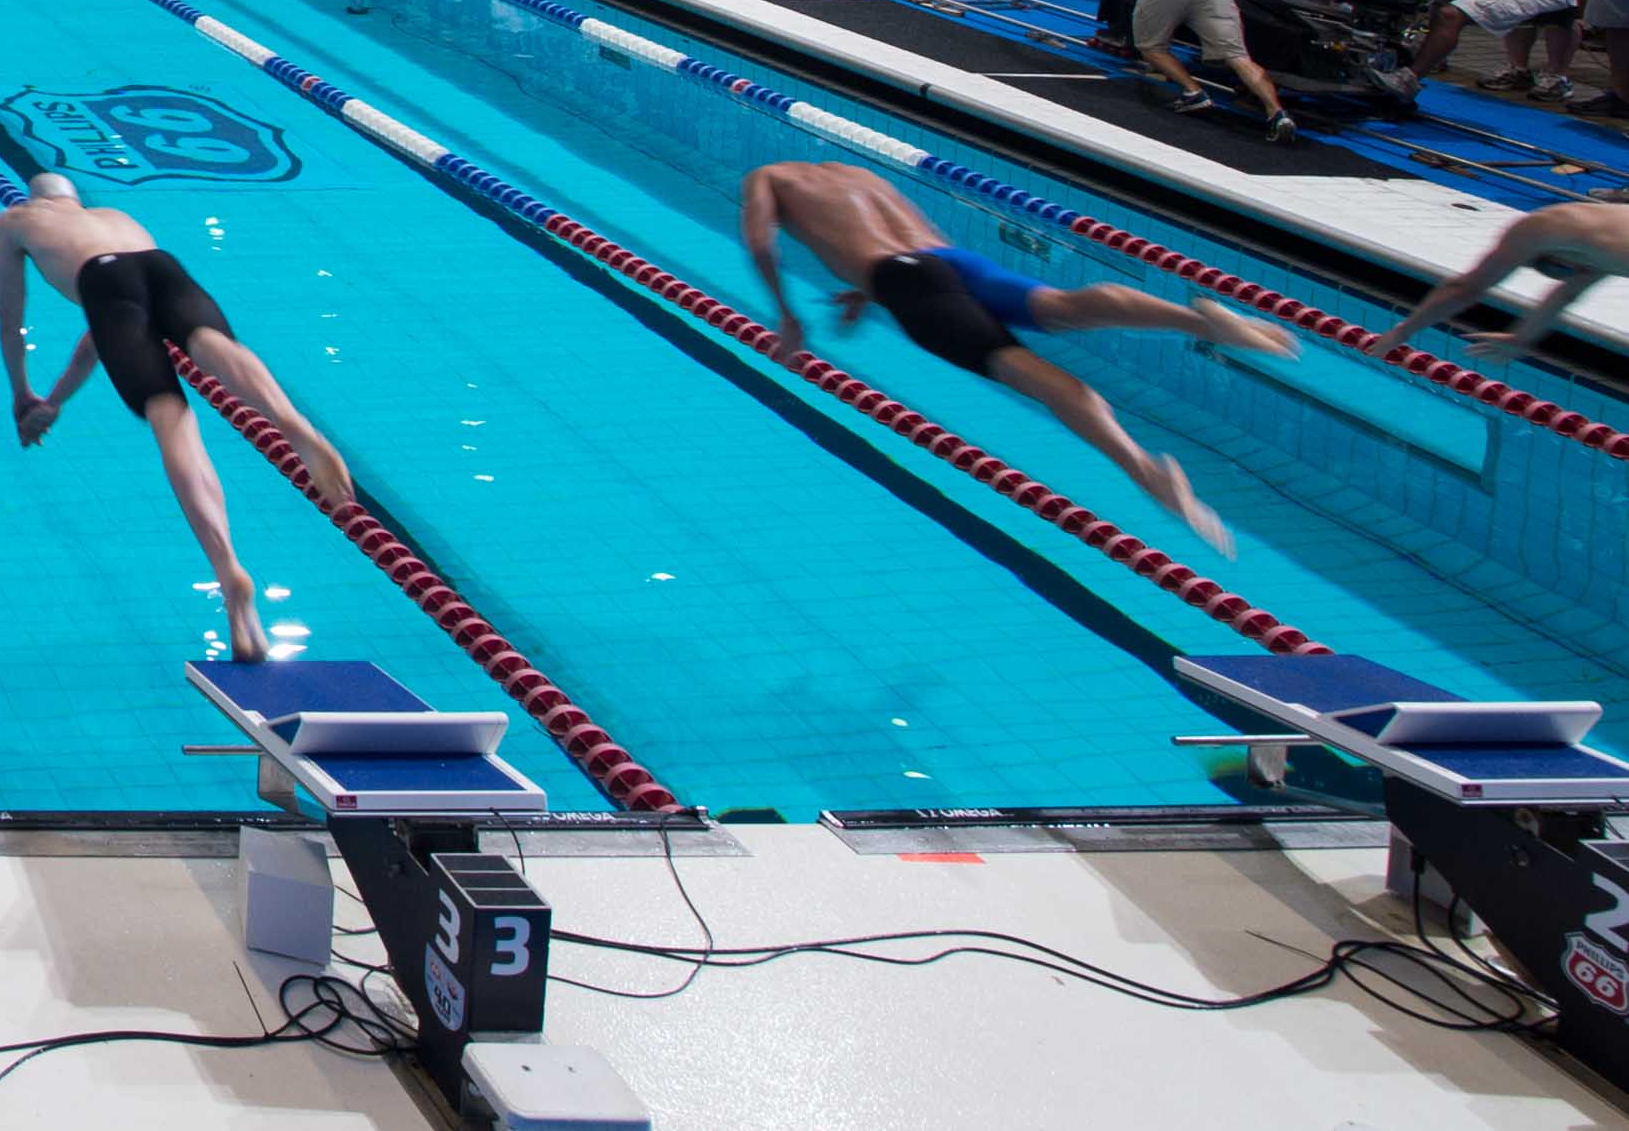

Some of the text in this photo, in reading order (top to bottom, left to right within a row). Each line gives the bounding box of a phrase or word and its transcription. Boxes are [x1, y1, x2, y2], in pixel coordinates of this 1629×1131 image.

[551, 811, 615, 822] OMEGA
[435, 888, 461, 964] 3
[1584, 871, 1629, 954] 2
[490, 916, 531, 976] 3
[1576, 938, 1625, 980] PHILLIPS
[1574, 960, 1619, 998] 66
